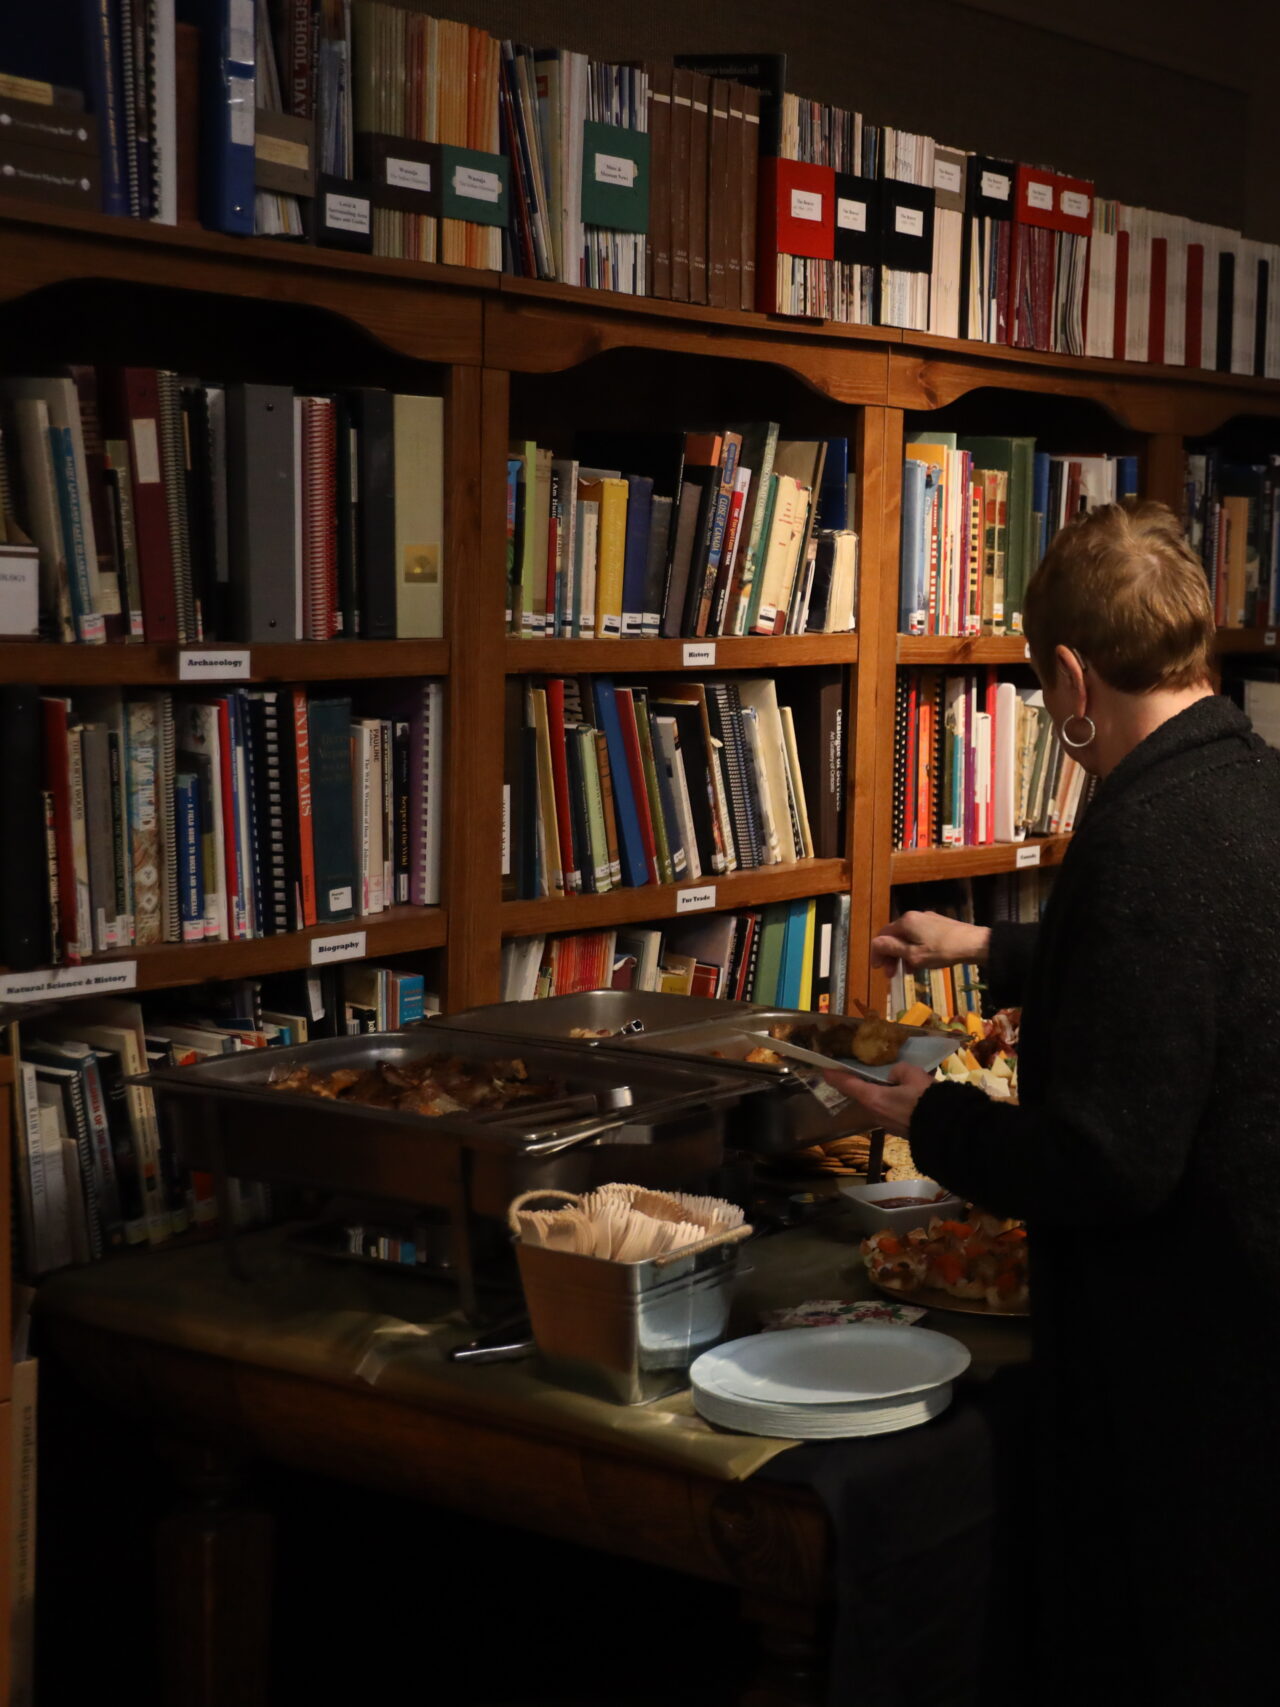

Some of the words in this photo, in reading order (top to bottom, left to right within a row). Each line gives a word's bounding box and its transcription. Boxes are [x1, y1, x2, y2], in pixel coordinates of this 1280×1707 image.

[552, 482, 558, 497] Am
[71, 505, 81, 522] AND
[717, 497, 729, 527] CLOSE-UP
[75, 544, 85, 554] TO
[712, 527, 723, 552] CANADA
[77, 555, 87, 575] LAKE
[187, 658, 243, 668] Archaeology
[296, 697, 308, 749] SIXTY
[835, 708, 843, 757] Catalogue
[73, 758, 83, 788] NORTH
[836, 758, 842, 769] of
[299, 754, 312, 817] YEARS
[75, 788, 84, 821] WOODS
[401, 794, 409, 821] Keeper
[401, 822, 409, 831] of
[401, 833, 409, 844] the
[401, 846, 409, 866] Wild
[49, 859, 58, 874] AND
[318, 941, 360, 953] Biography
[6, 984, 45, 995] Natural
[46, 980, 83, 990] Science
[94, 974, 128, 984] History
[29, 1107, 40, 1136] RAINY
[93, 1114, 105, 1127] OF
[31, 1139, 41, 1166] RIVER
[33, 1168, 43, 1196] LIVES
